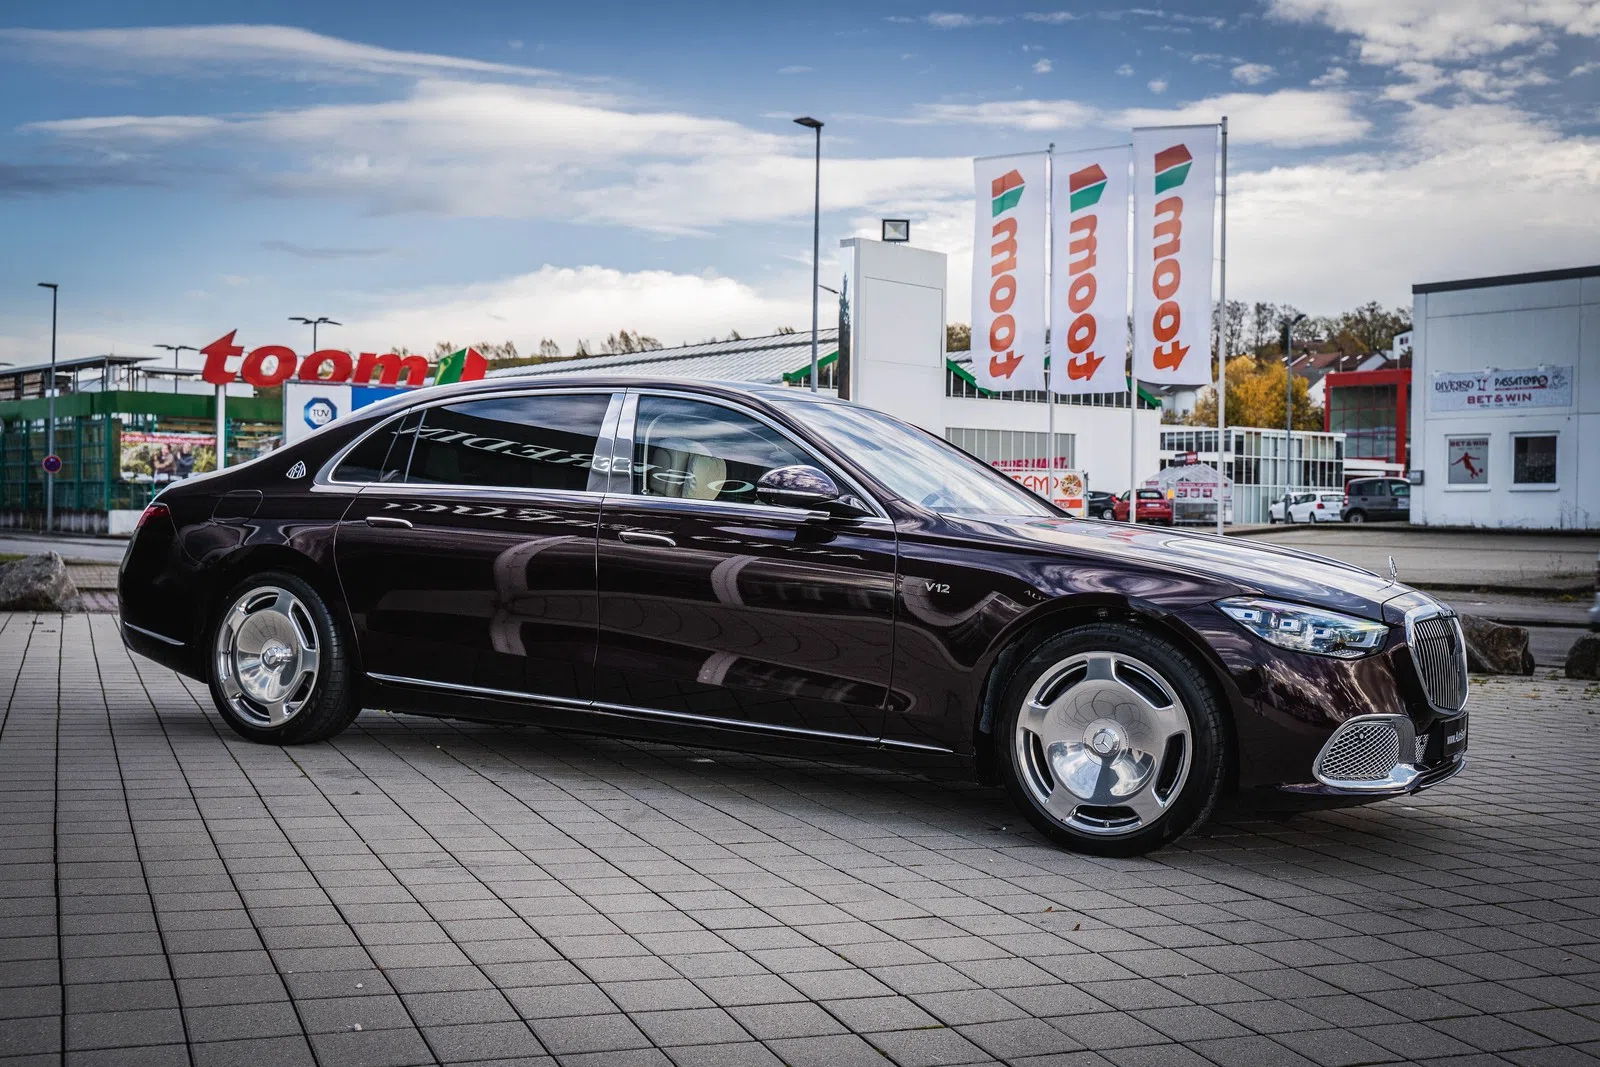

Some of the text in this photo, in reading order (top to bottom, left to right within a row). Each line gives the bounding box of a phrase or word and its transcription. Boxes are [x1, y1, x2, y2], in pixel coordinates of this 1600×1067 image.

[200, 329, 429, 387] toom
[989, 216, 1025, 380] toom
[1067, 214, 1106, 382] toom
[1152, 196, 1191, 371] toom
[925, 582, 950, 594] V12
